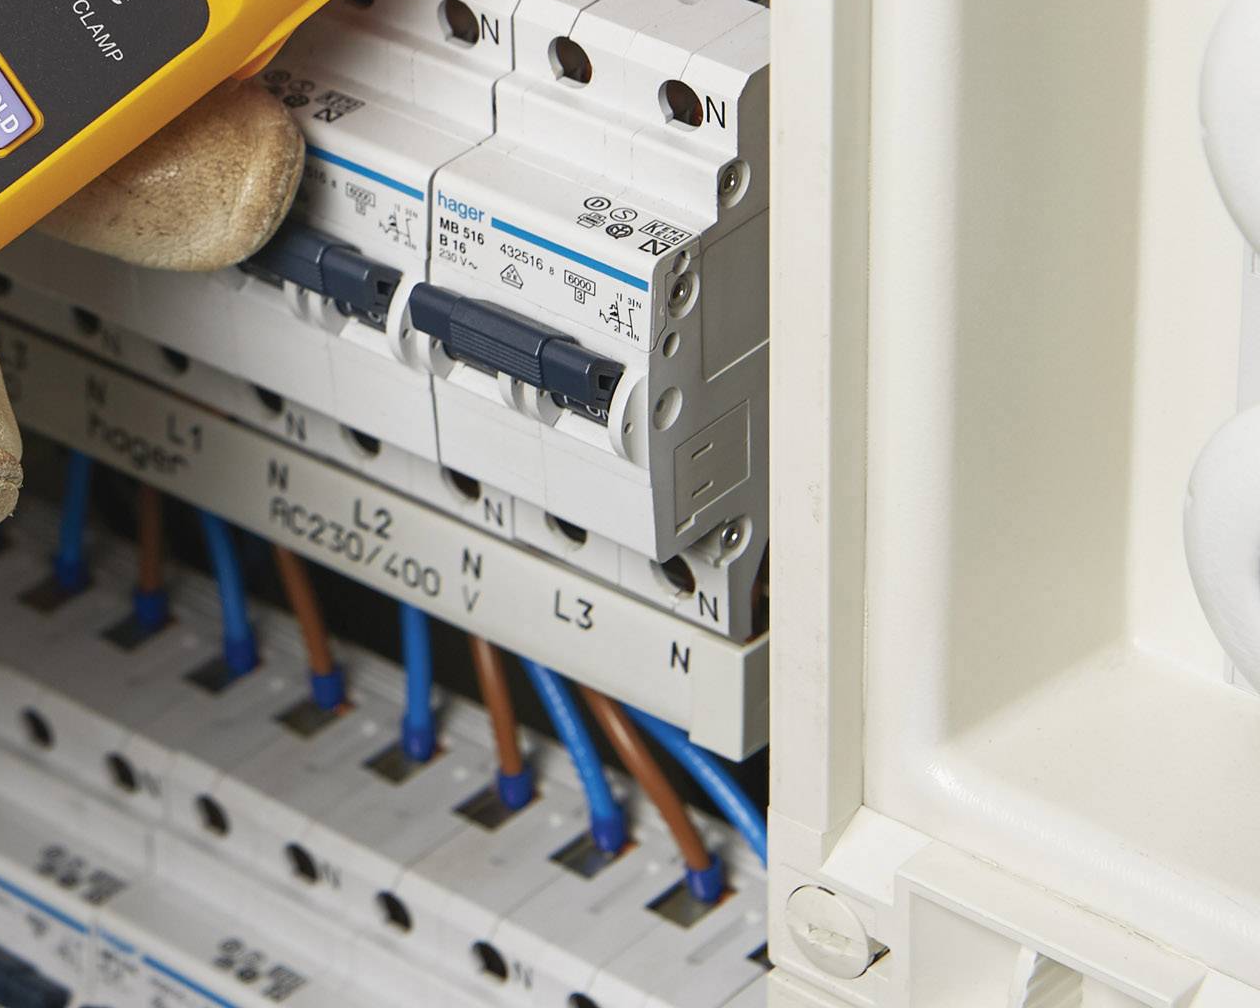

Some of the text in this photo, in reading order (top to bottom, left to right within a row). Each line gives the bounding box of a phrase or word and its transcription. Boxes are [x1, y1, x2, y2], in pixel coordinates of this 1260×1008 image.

[72, 0, 124, 63] CLAMP
[480, 14, 500, 46] N
[705, 95, 727, 130] N
[437, 189, 485, 223] hager
[439, 216, 459, 234] MB
[463, 226, 485, 246] 516
[439, 233, 467, 254] B 16
[439, 247, 457, 263] 230
[500, 242, 544, 271] 432516
[567, 273, 592, 291] 6000
[576, 290, 584, 302] 3
[285, 412, 306, 441] N
[267, 459, 289, 491] N
[353, 498, 393, 540] L2
[483, 497, 504, 527] N
[269, 495, 481, 613] AC230/400 V
[461, 548, 483, 580] N
[554, 589, 594, 630] L3
[697, 591, 719, 623] N
[670, 641, 691, 674] N
